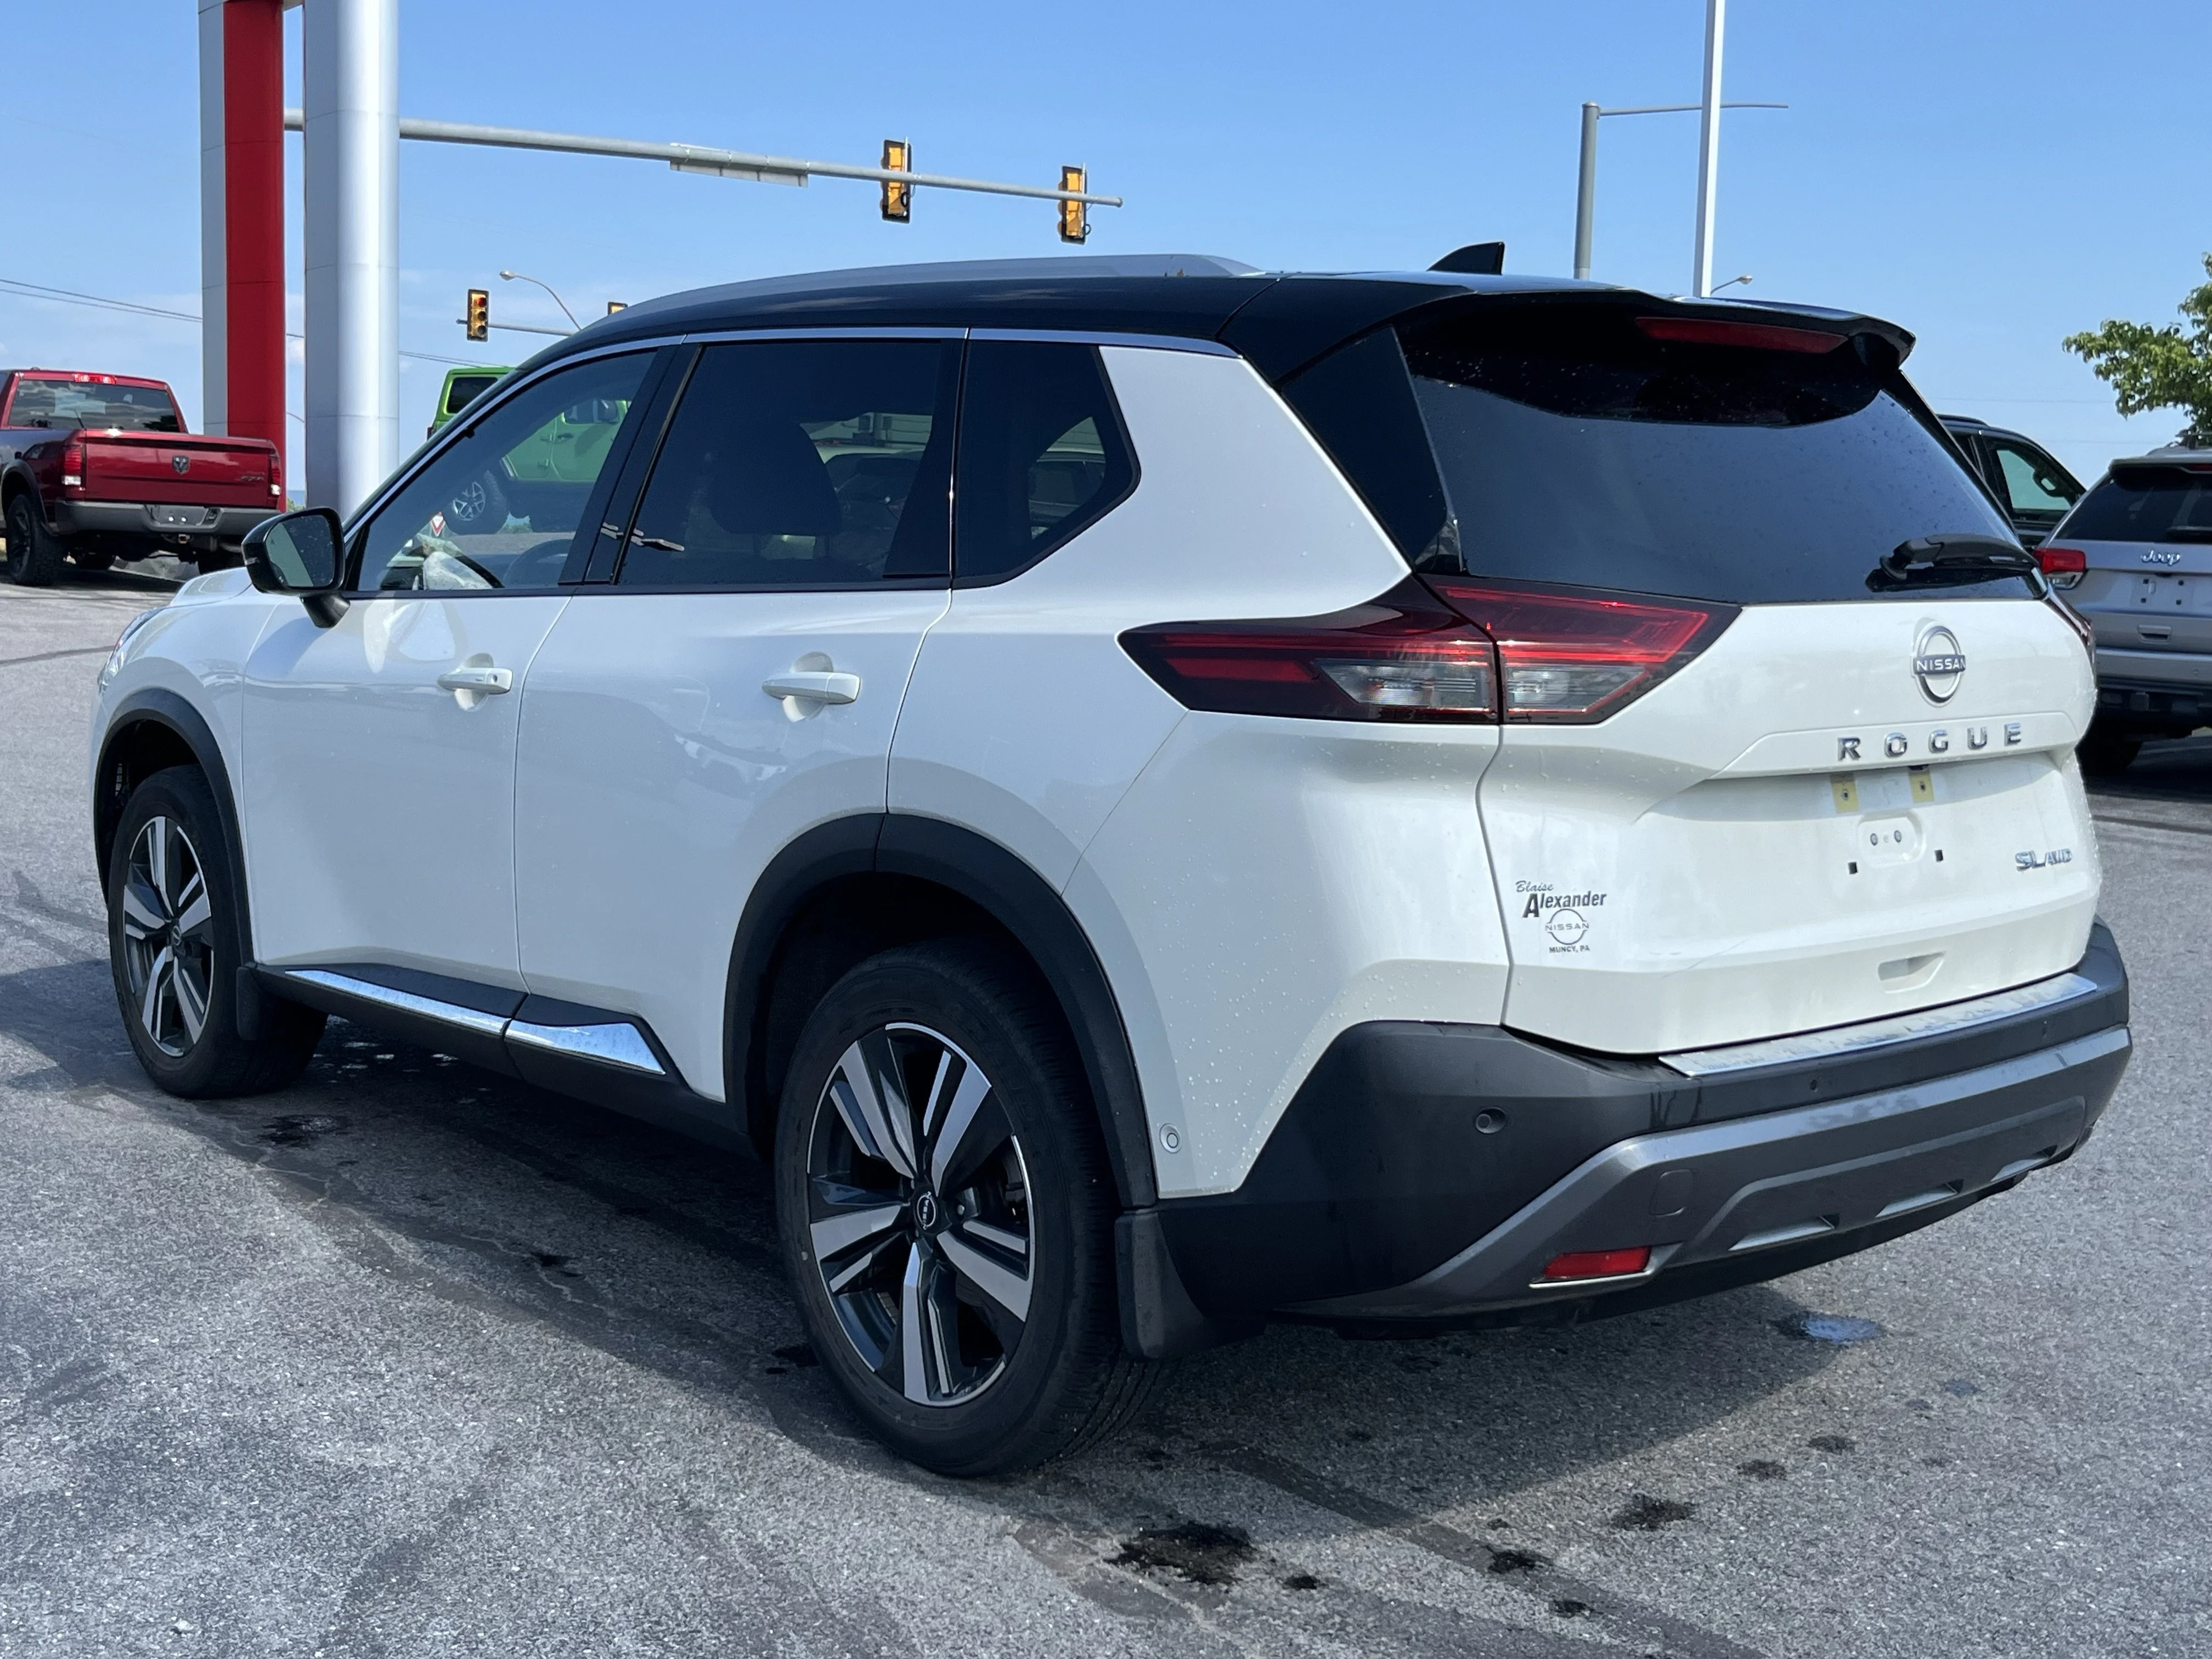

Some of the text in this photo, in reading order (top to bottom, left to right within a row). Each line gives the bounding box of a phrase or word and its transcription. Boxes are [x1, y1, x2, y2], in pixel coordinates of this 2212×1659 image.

[1916, 658, 1966, 671] NISSAN
[1837, 722, 2022, 761] ROGUE
[2015, 850, 2045, 871] SL
[1515, 880, 1554, 893] Blaise
[1522, 890, 1607, 918] Alexander
[1545, 922, 1589, 932] NISSAN
